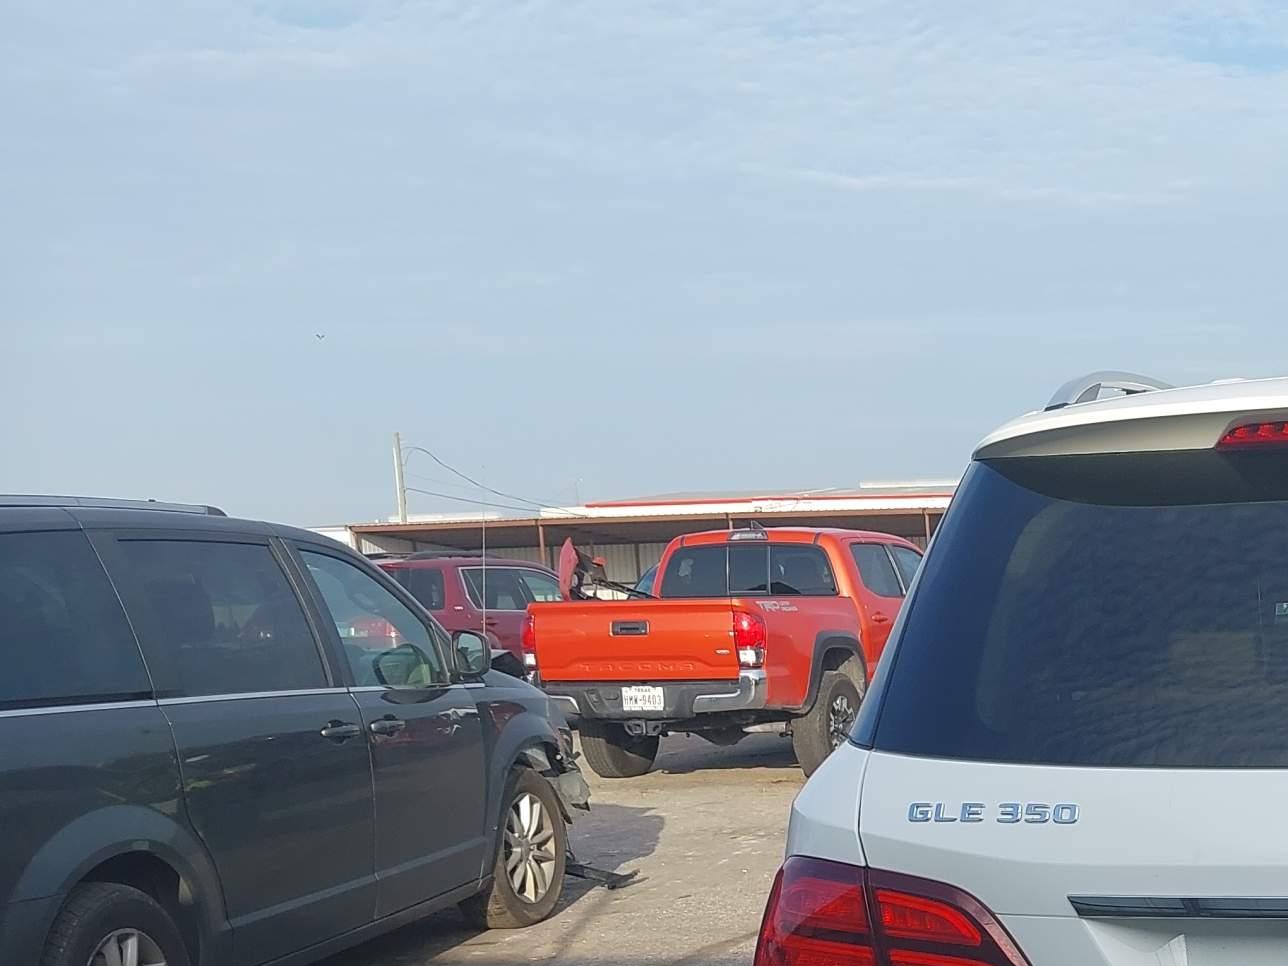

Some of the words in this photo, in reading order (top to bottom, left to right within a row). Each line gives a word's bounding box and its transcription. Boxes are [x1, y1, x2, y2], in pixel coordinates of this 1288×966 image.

[579, 662, 695, 672] TACOMA
[907, 802, 985, 823] GLE
[996, 802, 1080, 824] 350
